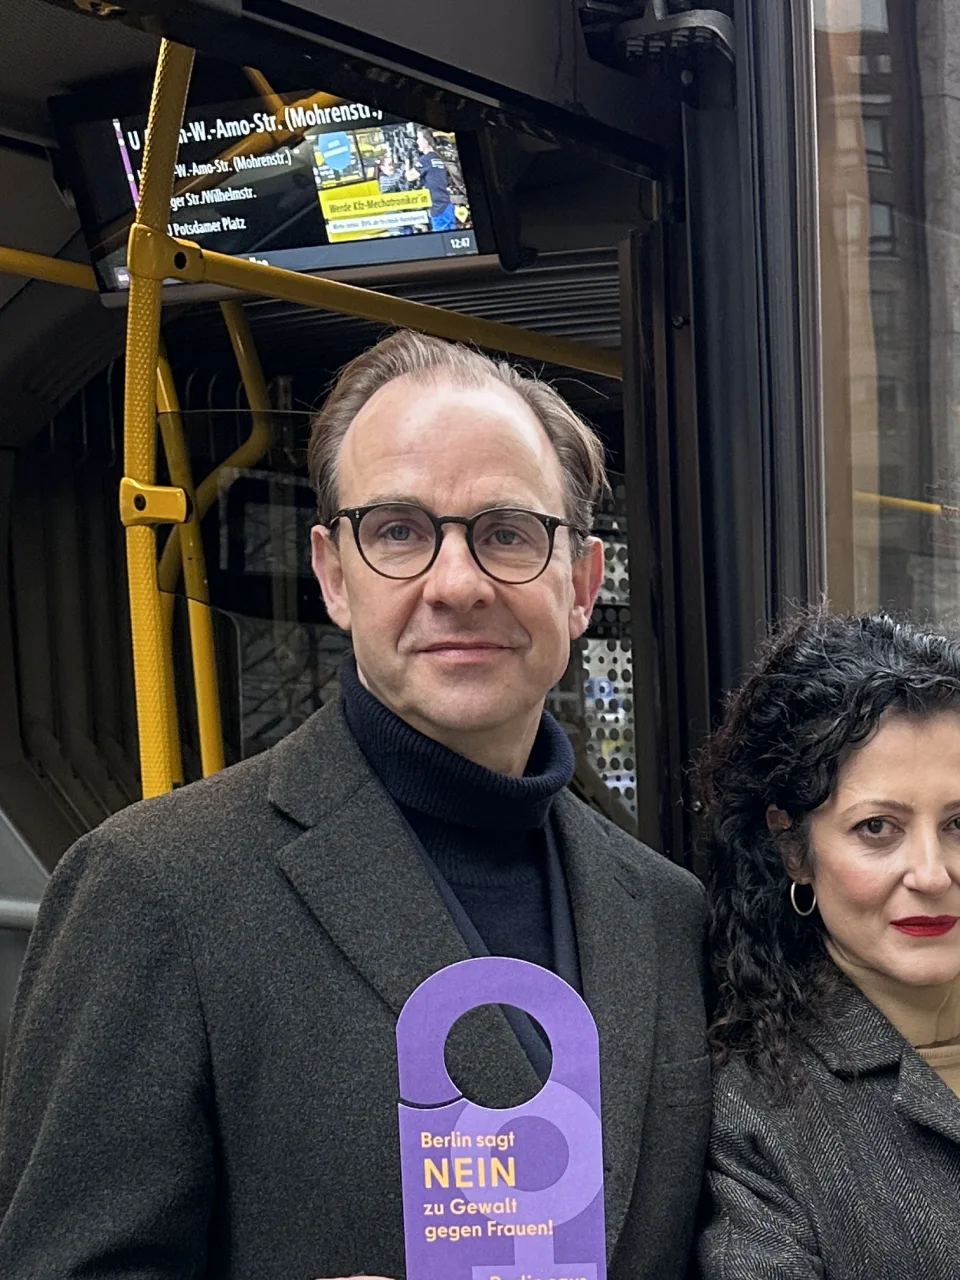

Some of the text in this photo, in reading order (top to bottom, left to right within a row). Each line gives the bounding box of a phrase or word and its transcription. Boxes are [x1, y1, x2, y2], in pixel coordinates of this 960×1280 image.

[128, 131, 140, 150] U
[233, 149, 292, 172] (Mohrenstr.)
[329, 203, 352, 213] Werde
[173, 220, 221, 236] Potsdamer
[221, 216, 247, 231] Platz
[450, 238, 470, 249] 12:47
[421, 1132, 514, 1150] Berlin sagt
[424, 1157, 516, 1188] NEIN
[424, 1198, 517, 1215] zu Gewalt
[425, 1220, 553, 1242] gegen Frauen!
